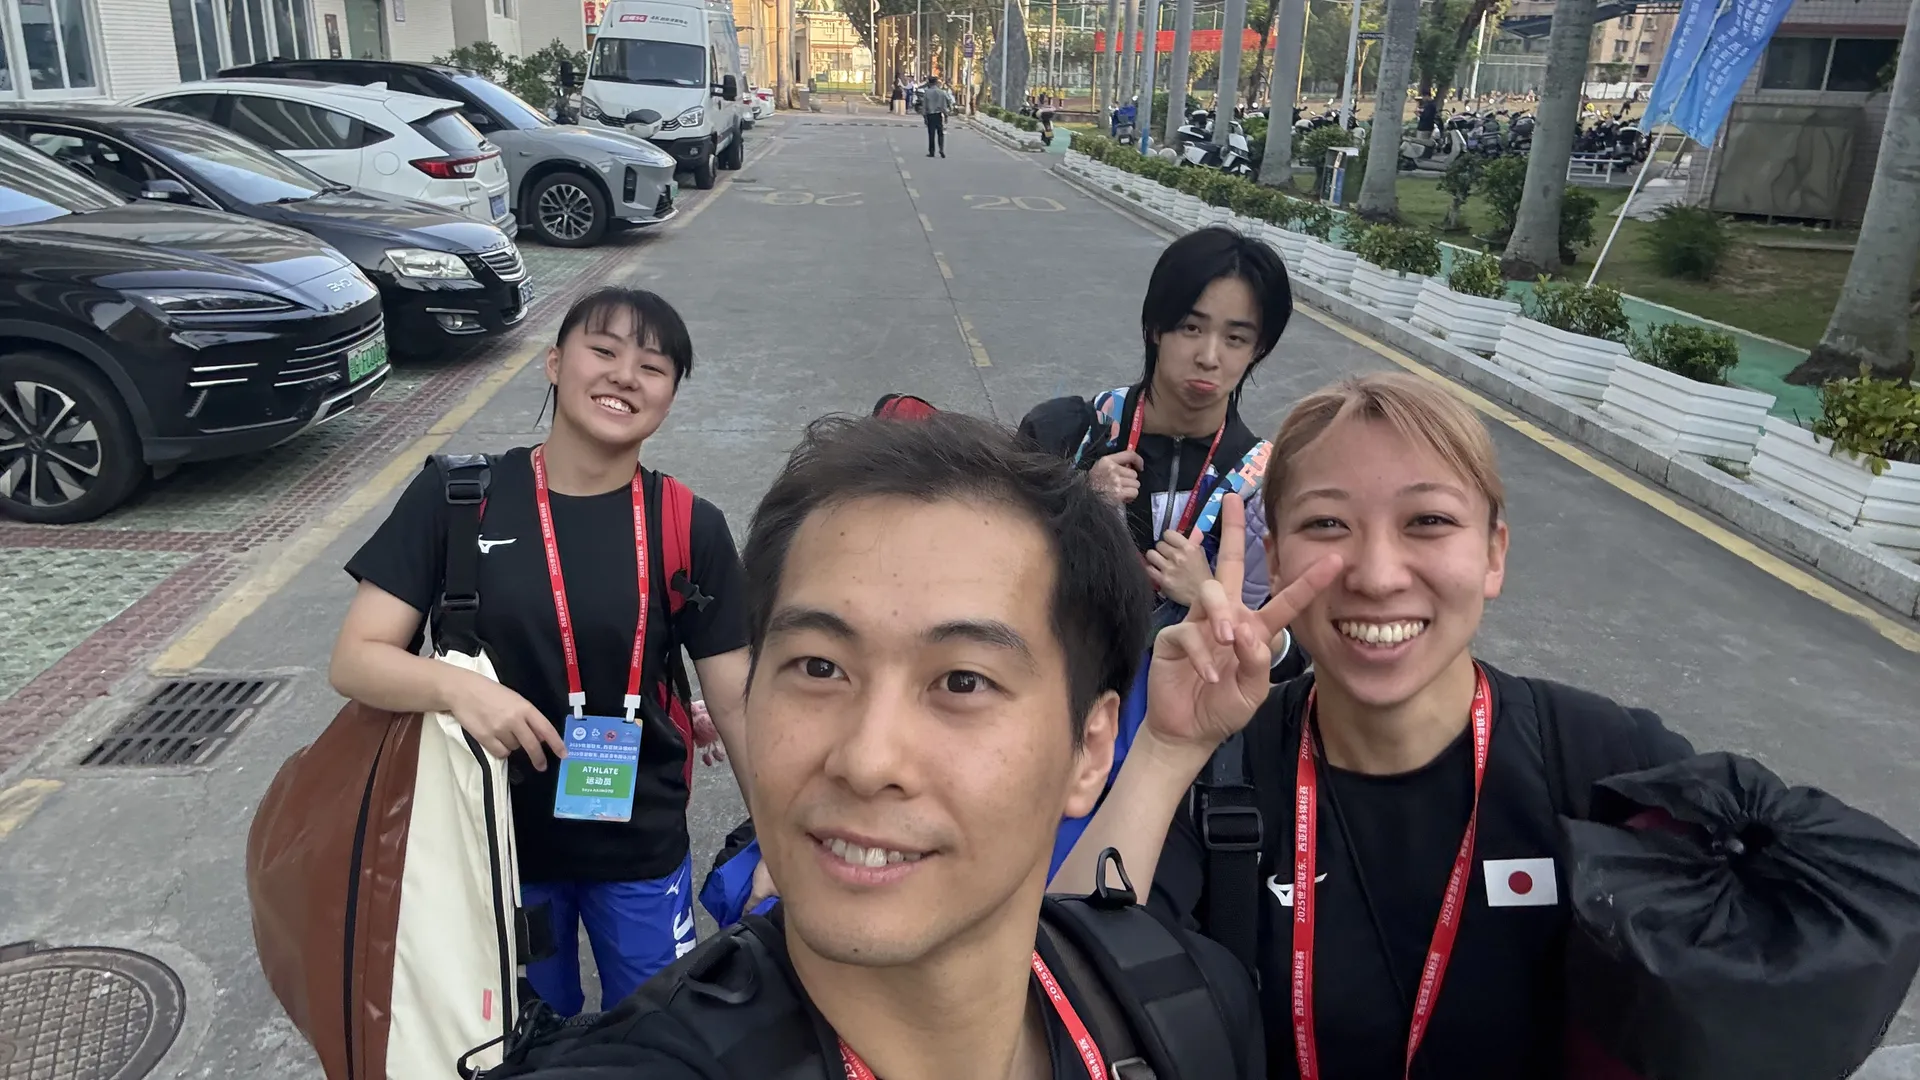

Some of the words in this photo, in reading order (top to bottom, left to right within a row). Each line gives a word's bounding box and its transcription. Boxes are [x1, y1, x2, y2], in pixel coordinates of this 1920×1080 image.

[962, 194, 1067, 212] 20
[582, 766, 619, 775] ATHLATE
[586, 776, 611, 786] 运动员
[1078, 1037, 1103, 1080] 锦标赛
